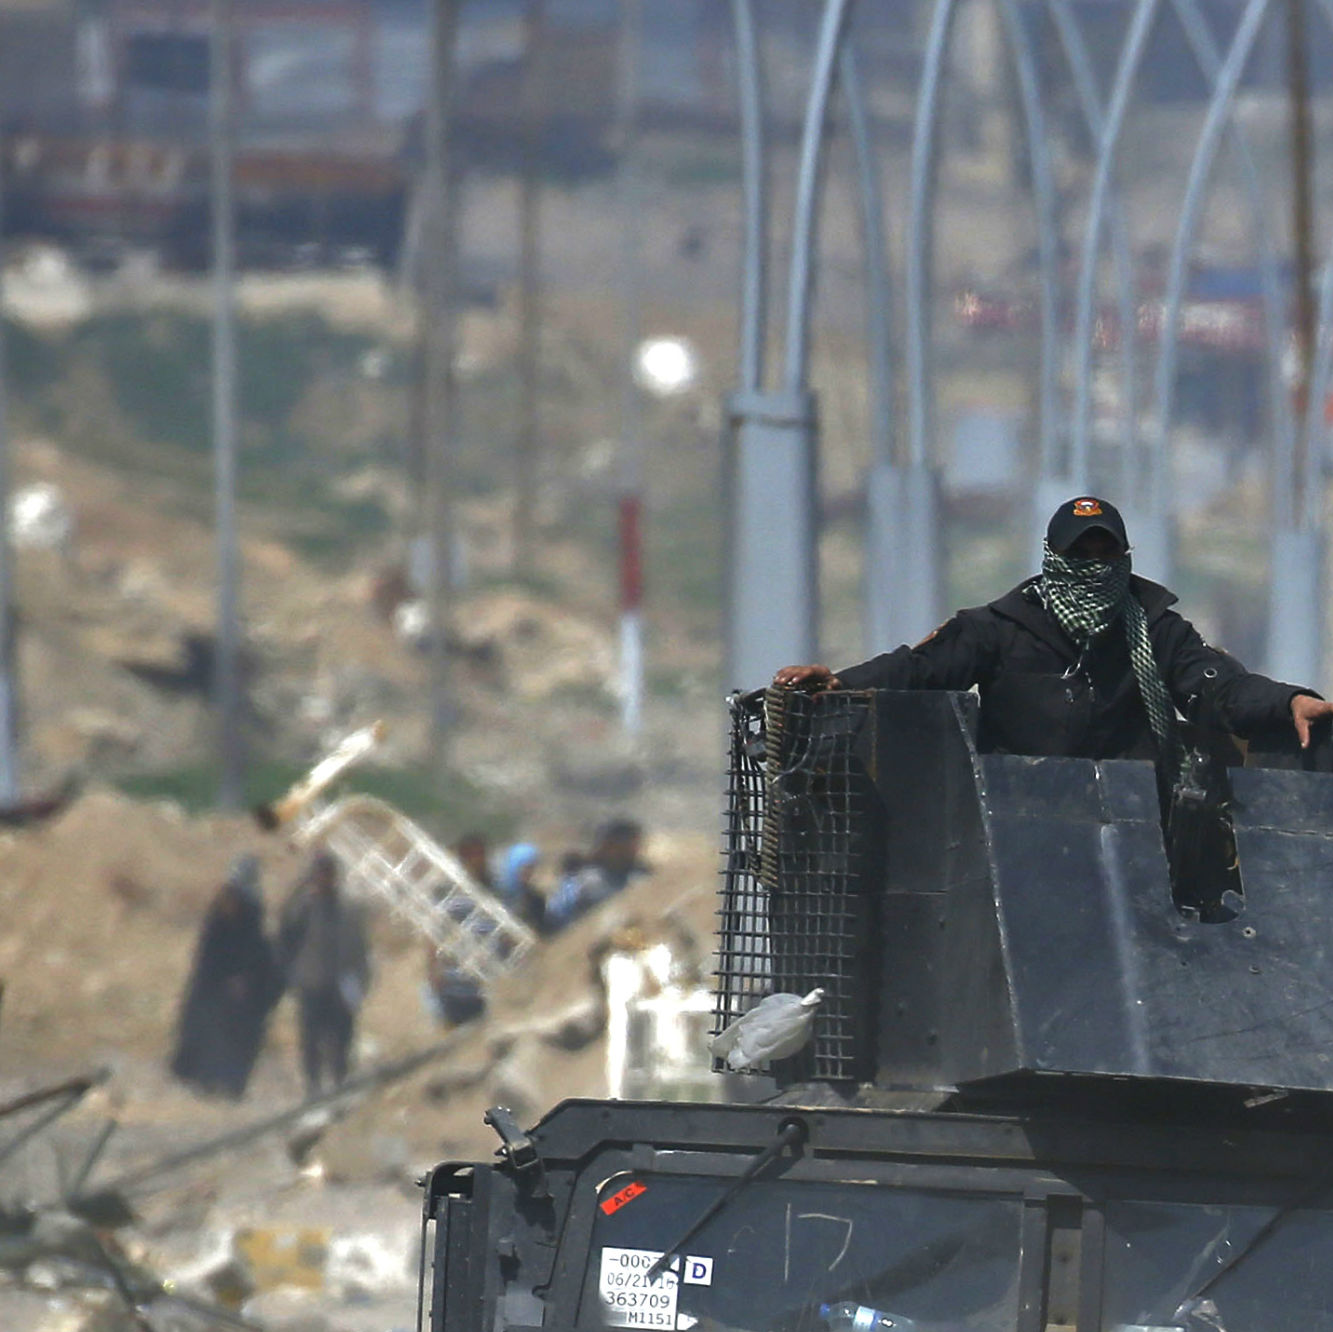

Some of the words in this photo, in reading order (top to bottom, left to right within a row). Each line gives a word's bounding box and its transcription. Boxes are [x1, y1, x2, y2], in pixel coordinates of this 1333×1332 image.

[691, 1262, 707, 1280] D
[606, 1290, 671, 1309] 363709
[628, 1311, 673, 1326] M1151
